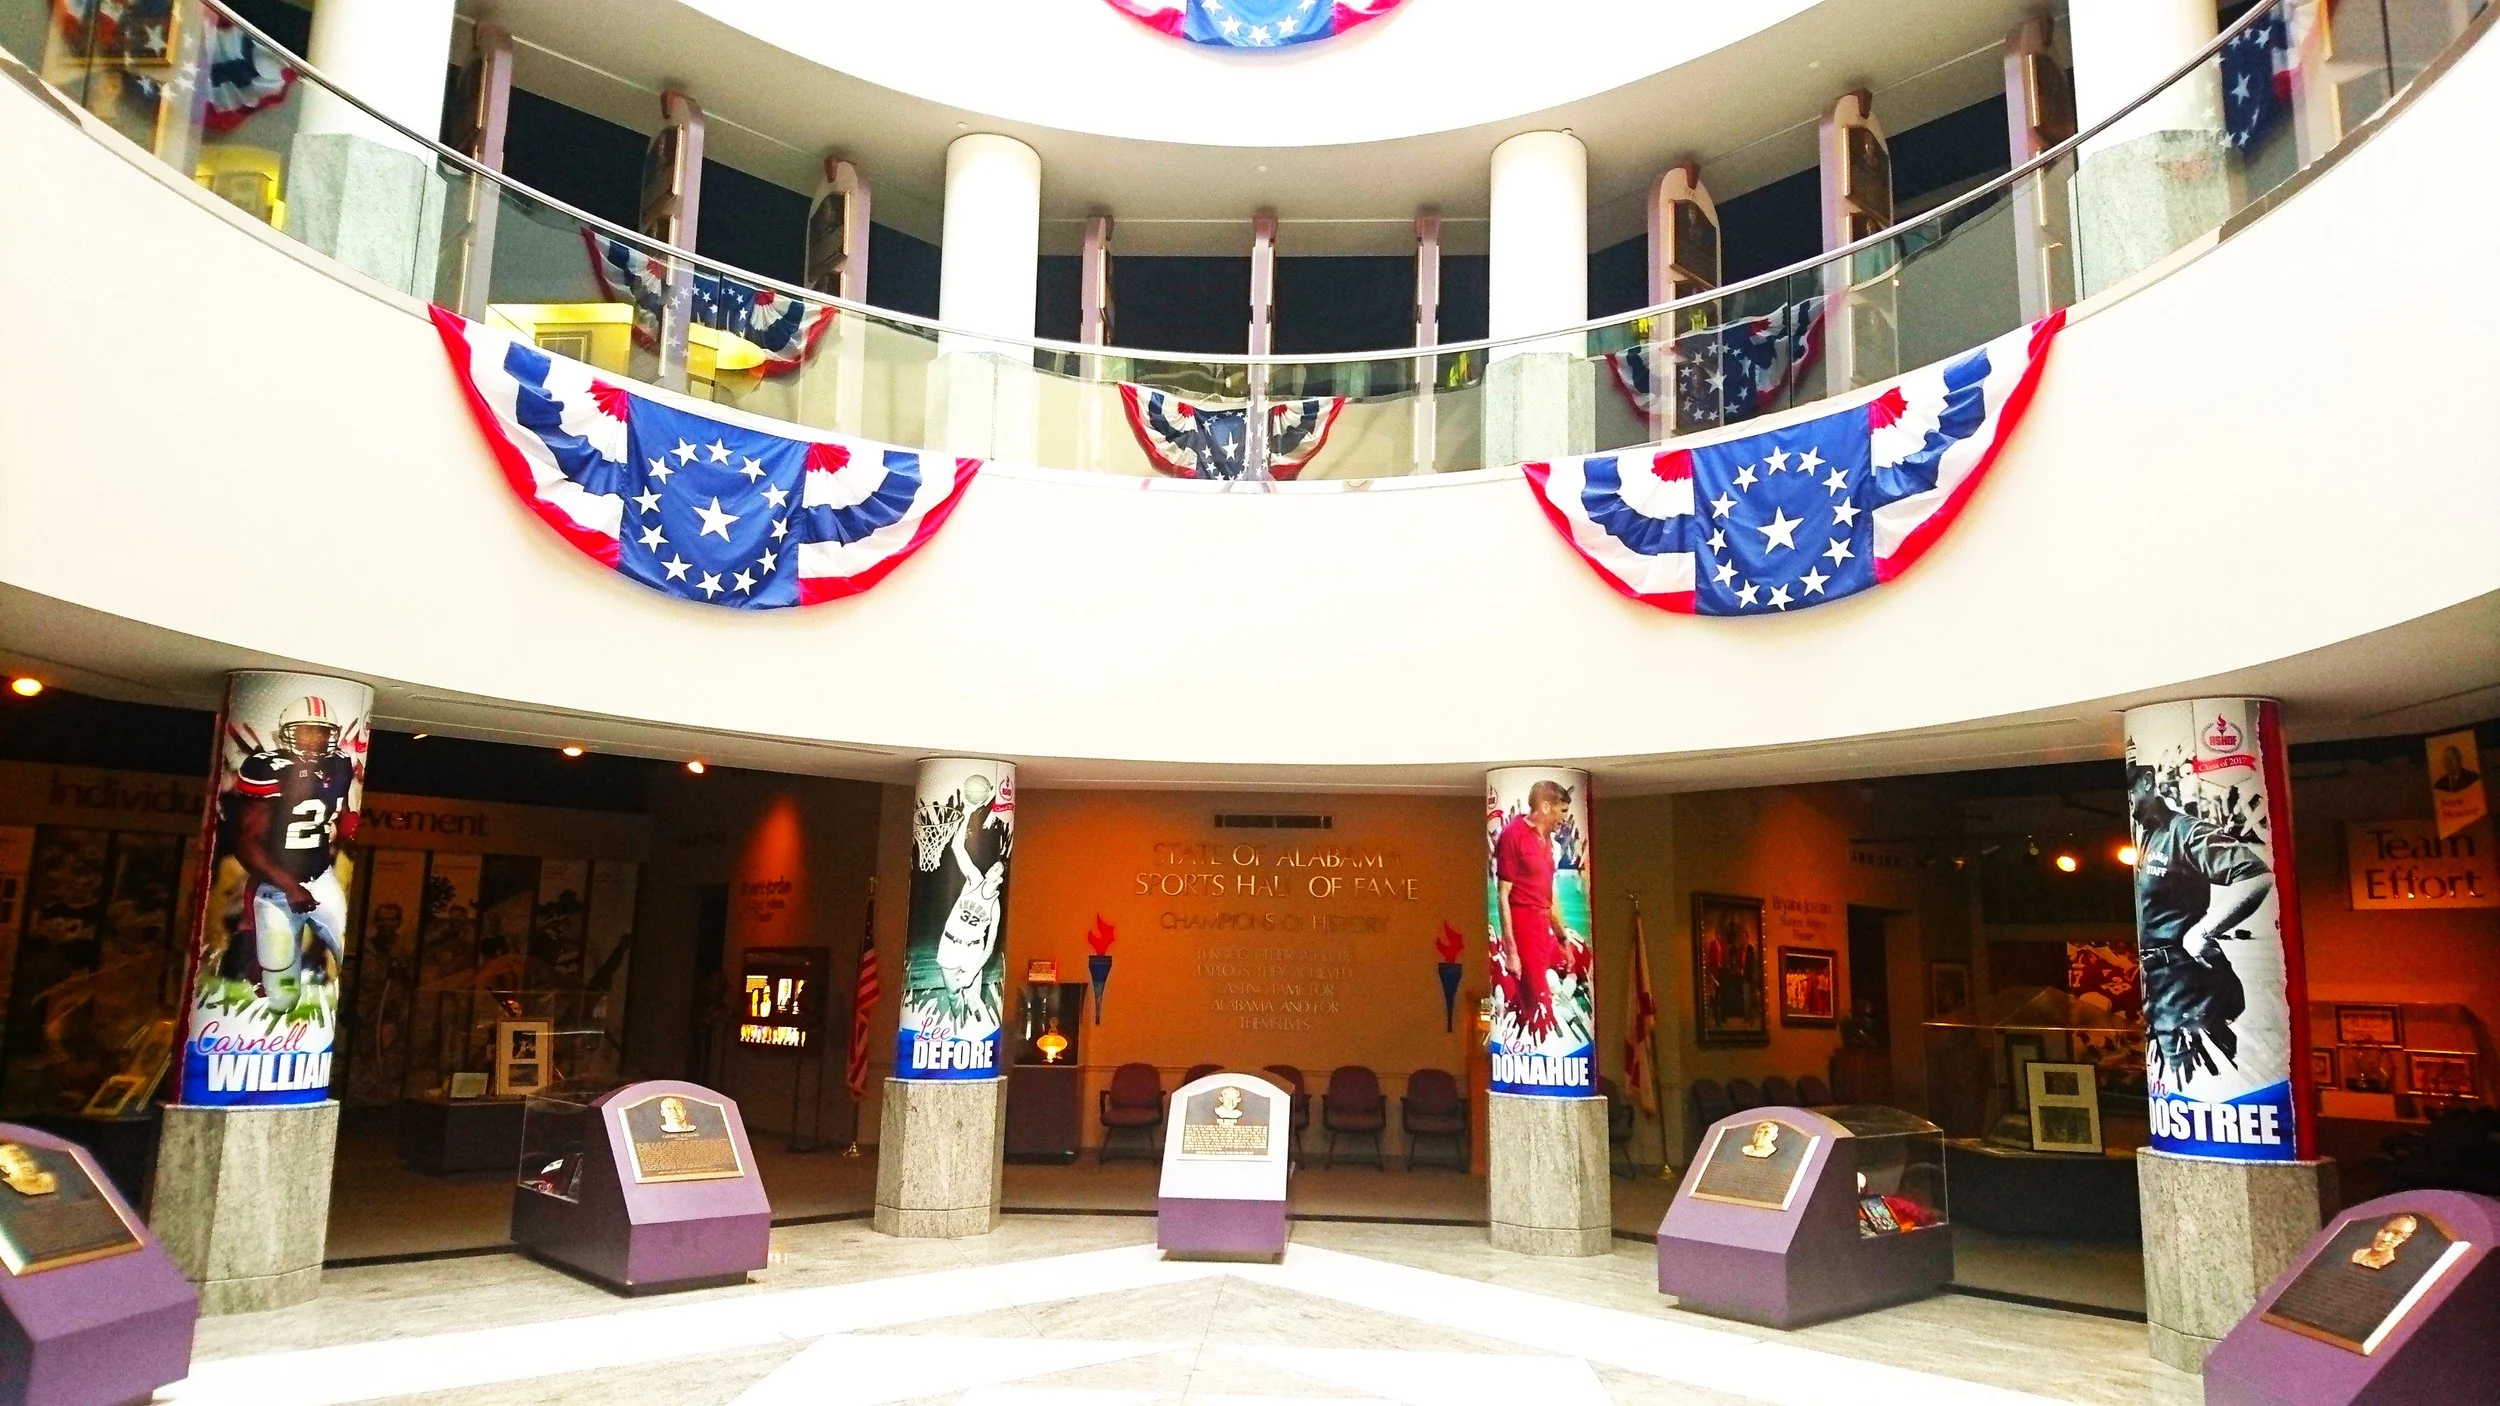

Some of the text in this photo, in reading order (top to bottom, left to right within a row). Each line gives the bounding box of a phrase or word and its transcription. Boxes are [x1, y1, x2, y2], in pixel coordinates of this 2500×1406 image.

[2220, 758, 2229, 768] of
[2229, 756, 2248, 766] 2017
[48, 770, 490, 837] Individu vement
[1152, 841, 1224, 866] STATE
[1232, 843, 1266, 867] OF
[2365, 828, 2476, 860] Team
[1136, 871, 1225, 897] SPORTS
[1308, 874, 1343, 899] OF
[1354, 876, 1419, 901] FAME
[2365, 865, 2484, 900] Effort
[960, 909, 981, 927] 32
[1280, 999, 1311, 1013] AND
[197, 1020, 308, 1053] Carnell
[915, 1016, 951, 1041] Lee
[1501, 1029, 1538, 1055] Ken
[912, 1038, 994, 1070] DEFORE
[1492, 1052, 1590, 1087] DONAHUE
[208, 1051, 333, 1092] WILLIAM
[2149, 1079, 2169, 1097] im
[2149, 1096, 2281, 1145] OOSTREE
